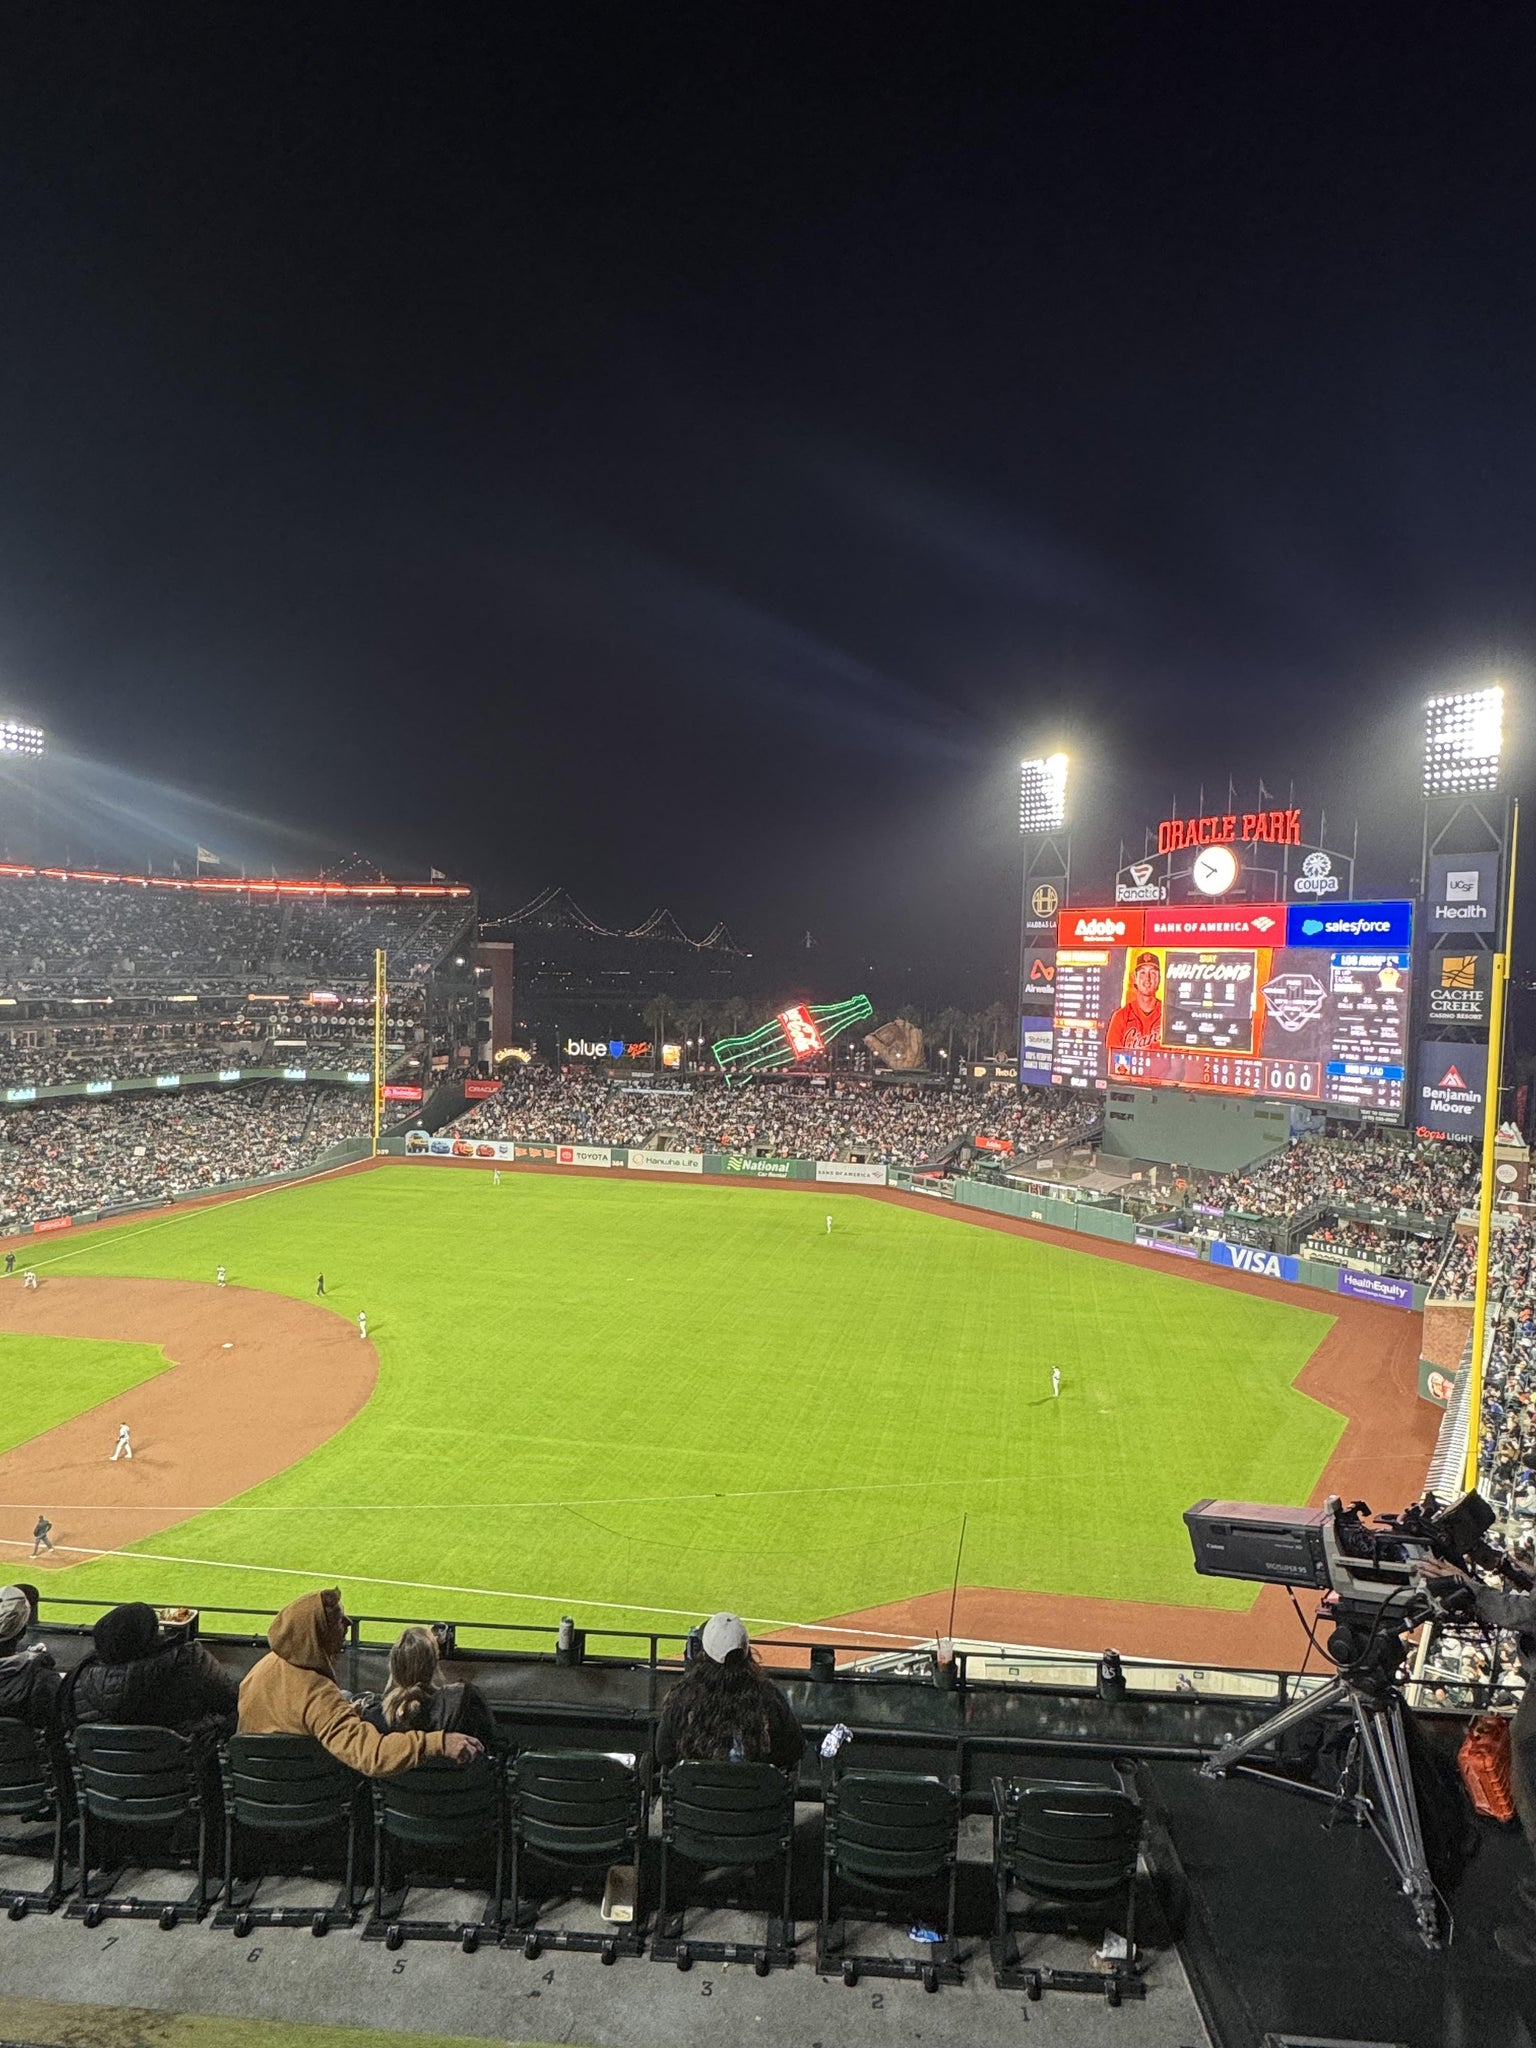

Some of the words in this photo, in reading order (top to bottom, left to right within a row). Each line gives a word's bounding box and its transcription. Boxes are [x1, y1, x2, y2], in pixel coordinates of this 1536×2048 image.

[1158, 816, 1236, 854] ORACLE
[1242, 809, 1301, 845] PARK
[1296, 876, 1338, 893] coupa
[1450, 880, 1474, 892] UCSF
[1117, 886, 1166, 900] Fanatics
[1435, 905, 1487, 918] Health
[1075, 918, 1126, 935] Adobe
[1154, 924, 1182, 932] BANK
[1184, 923, 1197, 931] OF
[1199, 922, 1250, 932] AMERICA
[1325, 918, 1391, 935] salesforce
[1166, 963, 1252, 981] WHITCOMB
[1025, 984, 1055, 993] Airwalle
[1431, 989, 1484, 1001] CACHE
[1431, 1001, 1482, 1012] CREEK
[567, 1038, 608, 1056] blue
[1204, 1063, 1210, 1073] 2
[1213, 1065, 1219, 1073] 5
[1222, 1065, 1228, 1074] 0
[1235, 1066, 1241, 1075] 2
[1244, 1067, 1251, 1077] 4
[1255, 1068, 1260, 1077] 1
[1203, 1074, 1210, 1083] 0
[1221, 1076, 1228, 1084] 0
[1254, 1079, 1260, 1088] 2
[1271, 1070, 1281, 1088] 0
[1285, 1072, 1295, 1089] 0
[1300, 1072, 1310, 1090] 0
[1422, 1086, 1482, 1103] Benjamin
[1416, 1126, 1446, 1140] Coors
[1447, 1133, 1474, 1143] LIGHT
[576, 1152, 609, 1161] TOYOTA
[645, 1157, 681, 1167] Hanwha
[682, 1160, 699, 1168] Life
[742, 1159, 790, 1173] National
[1307, 1241, 1349, 1256] WELCOME
[1357, 1251, 1367, 1259] TO
[1375, 1254, 1391, 1264] THE
[1226, 1245, 1282, 1277] VISA
[1344, 1274, 1408, 1298] HealthEquity
[101, 1936, 119, 1951] 7
[247, 1947, 264, 1962] 6
[392, 1958, 408, 1974] 5
[542, 1969, 555, 1985] 4
[701, 1981, 714, 1996] 3
[871, 1993, 885, 2009] 2
[1021, 2006, 1031, 2022] 1
